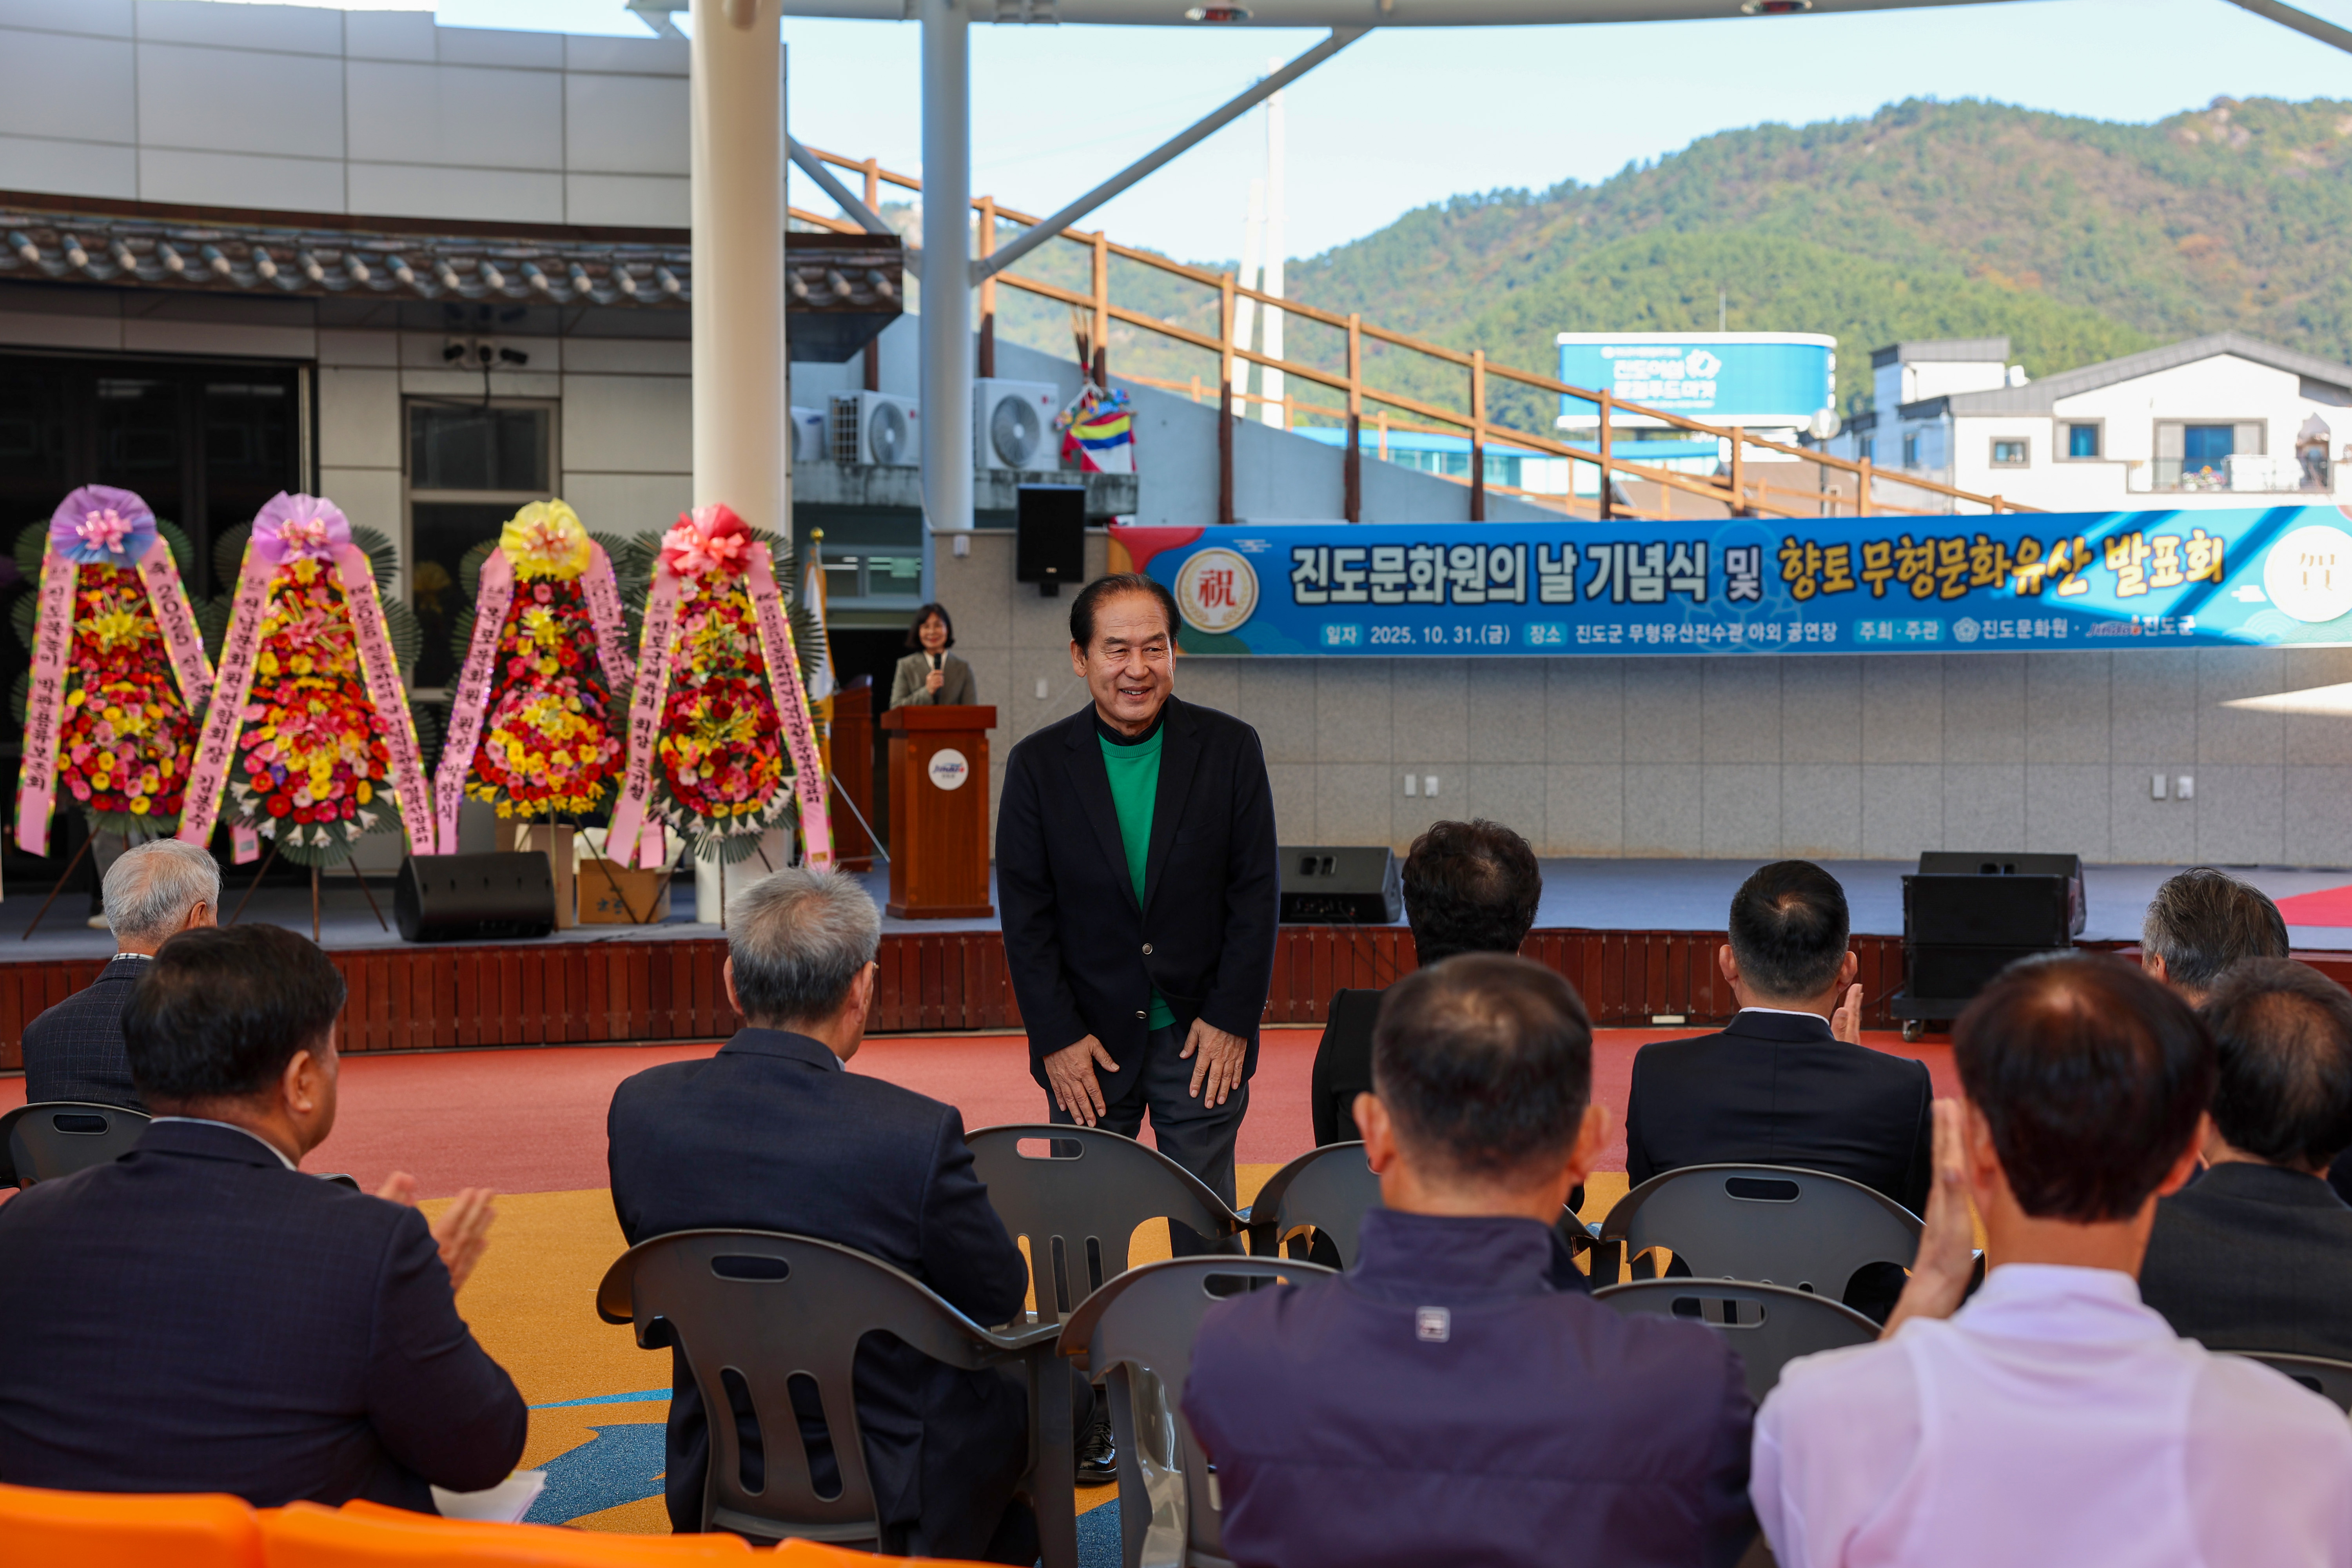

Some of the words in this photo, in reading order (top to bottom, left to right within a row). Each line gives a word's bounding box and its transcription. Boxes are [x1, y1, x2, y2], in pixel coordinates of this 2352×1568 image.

[1291, 546, 1526, 603] 진도문화원의
[1538, 543, 1577, 602] 날
[1586, 543, 1706, 602] 기념식
[1726, 546, 1760, 601] 및
[1779, 535, 1855, 601] 향토
[1861, 535, 2092, 599] 무형문화유산
[2103, 529, 2224, 597] 발표회
[1198, 568, 1236, 608] 祝
[1326, 625, 1357, 646] 일자
[1370, 626, 1417, 644] 2025.
[1423, 626, 1448, 644] 10.
[1530, 624, 1562, 645] 장소
[1575, 622, 1623, 644] 진도군
[1628, 622, 1745, 644] 무형유산전수관
[1748, 621, 1782, 643] 야외
[1786, 621, 1838, 643] 공연장
[1982, 617, 2069, 640] 진도문화원
[2141, 614, 2197, 637] 진도군
